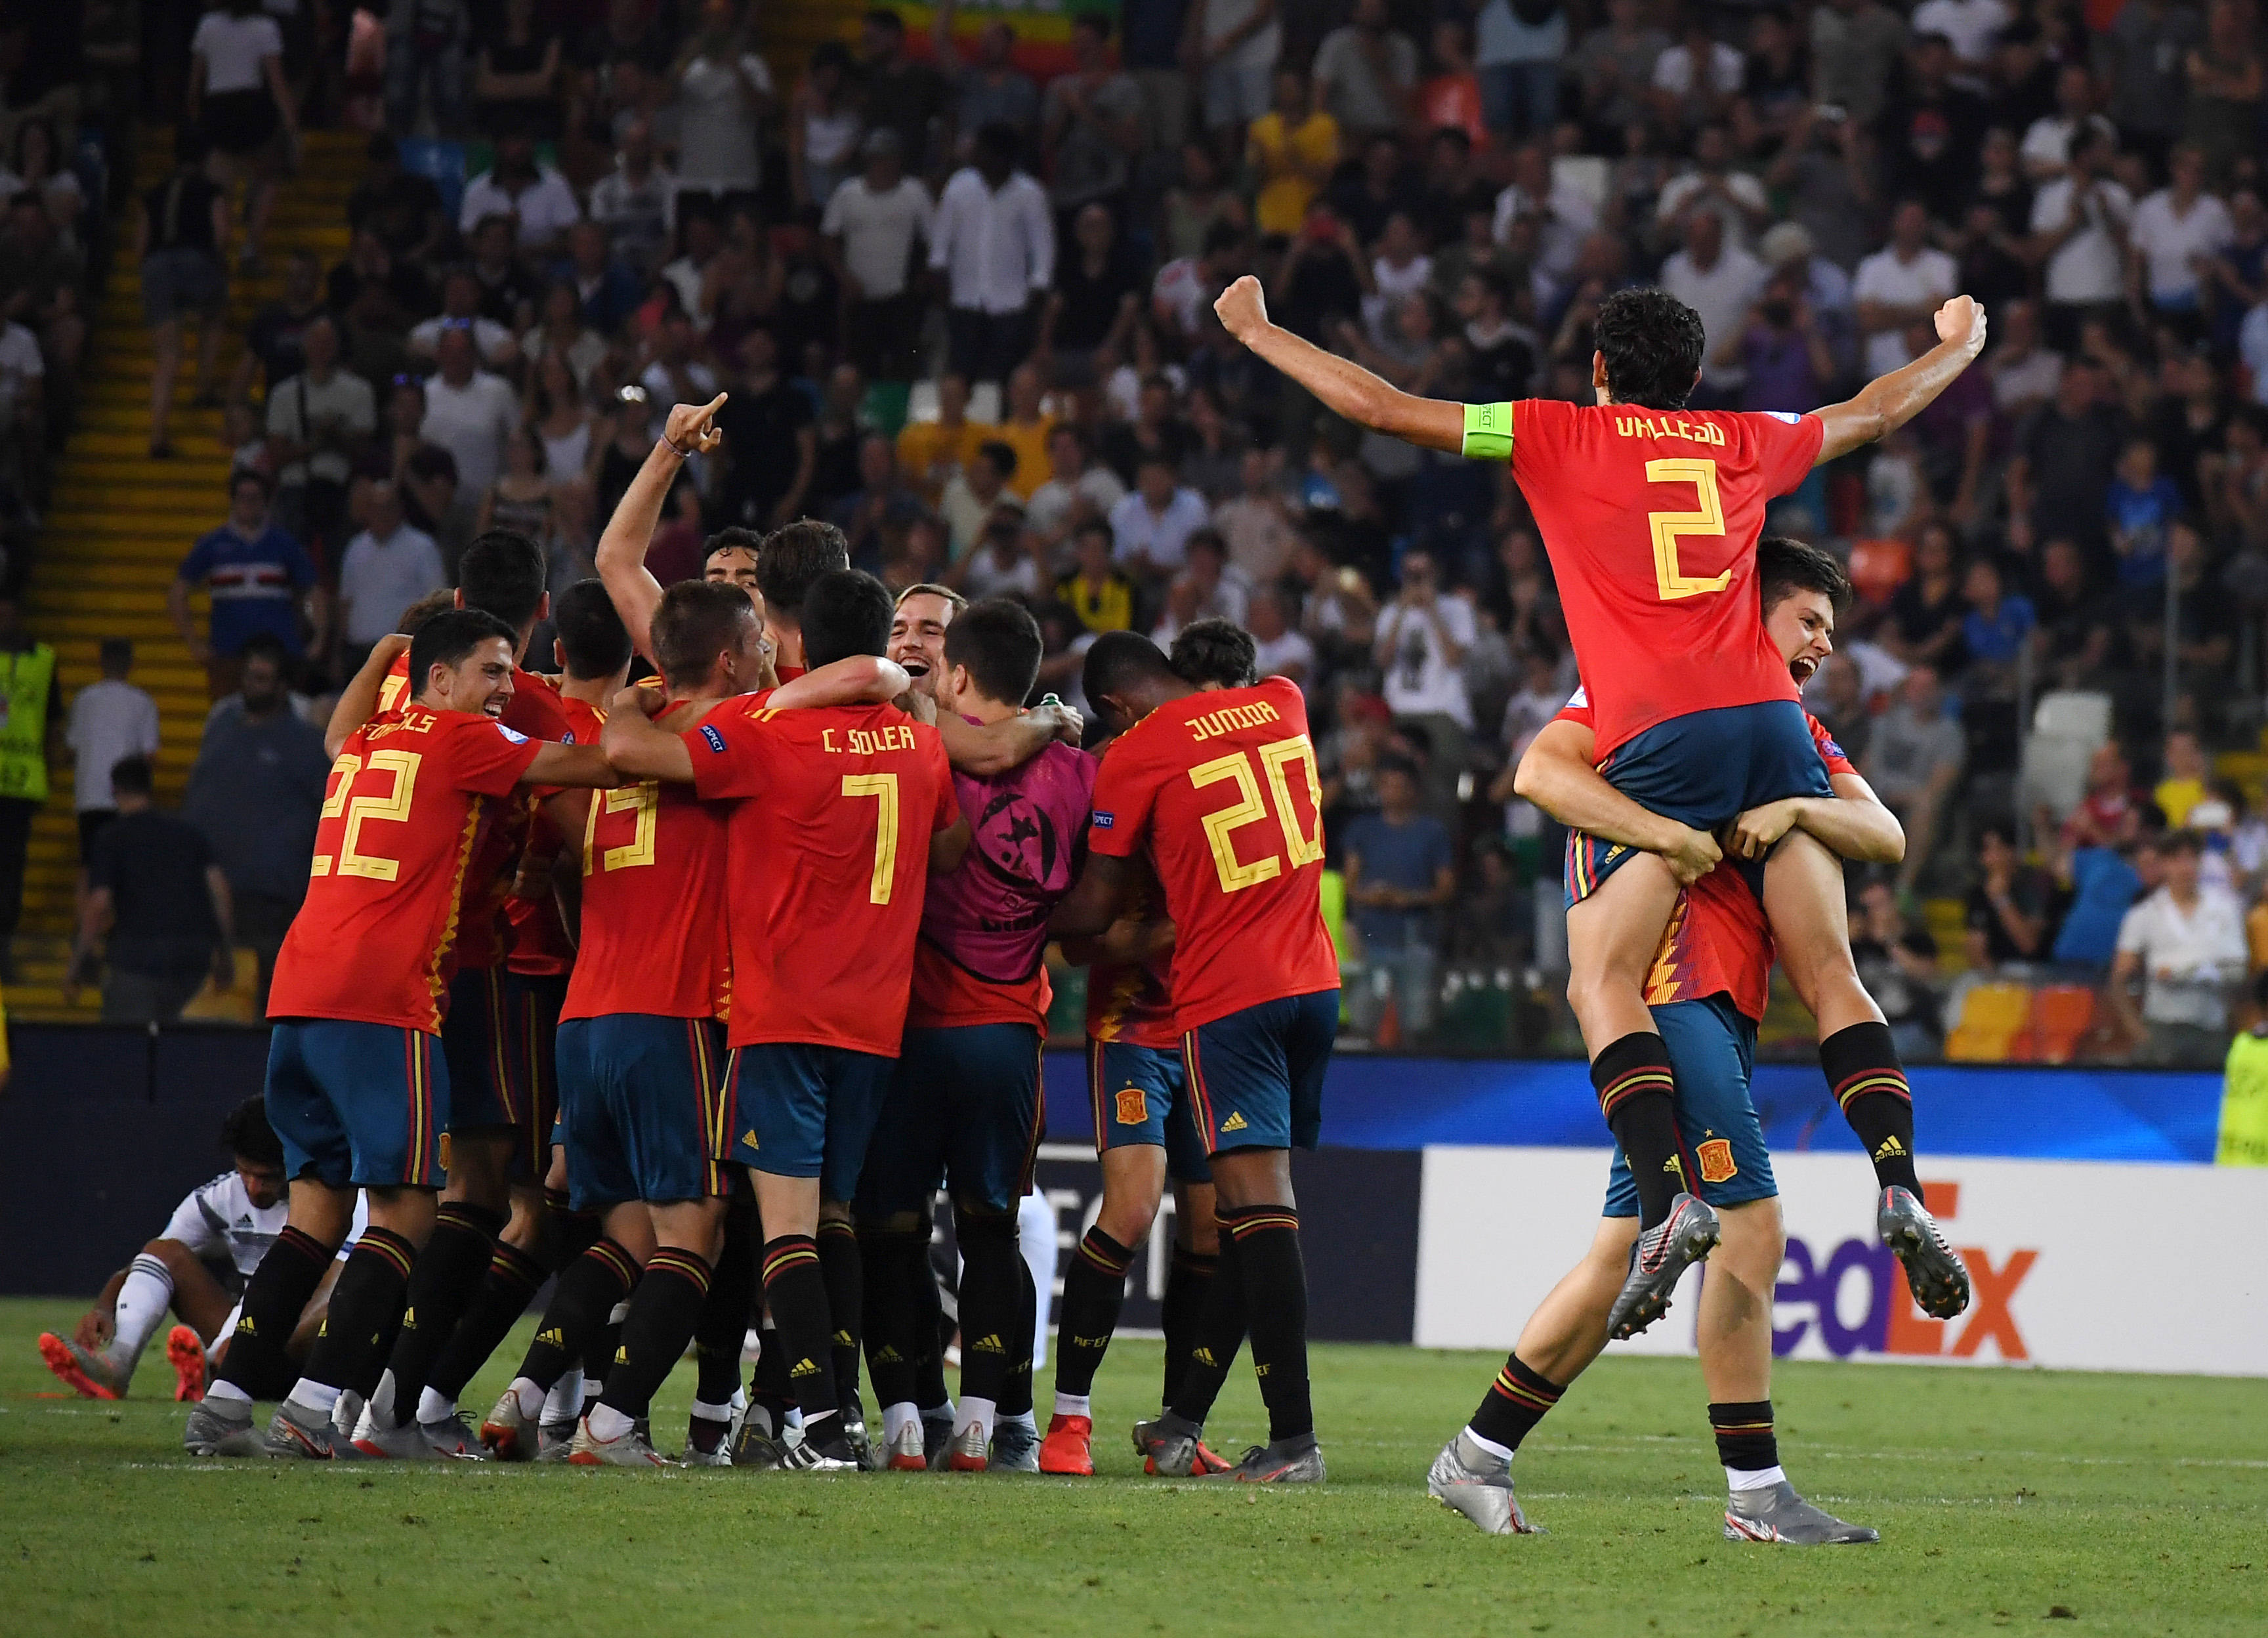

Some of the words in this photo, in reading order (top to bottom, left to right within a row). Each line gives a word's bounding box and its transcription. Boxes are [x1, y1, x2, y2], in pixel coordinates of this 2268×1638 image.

[1615, 416, 1725, 446] VALLEJO
[1645, 458, 1731, 600] 2
[822, 728, 843, 753] C.
[847, 725, 915, 755] SOLER
[1184, 700, 1280, 742] JUNIOR
[310, 749, 423, 881] 22
[841, 772, 898, 906] 7
[1188, 734, 1325, 893] 20
[1874, 1149, 1907, 1164] adidas
[1696, 1179, 2039, 1360] edEx
